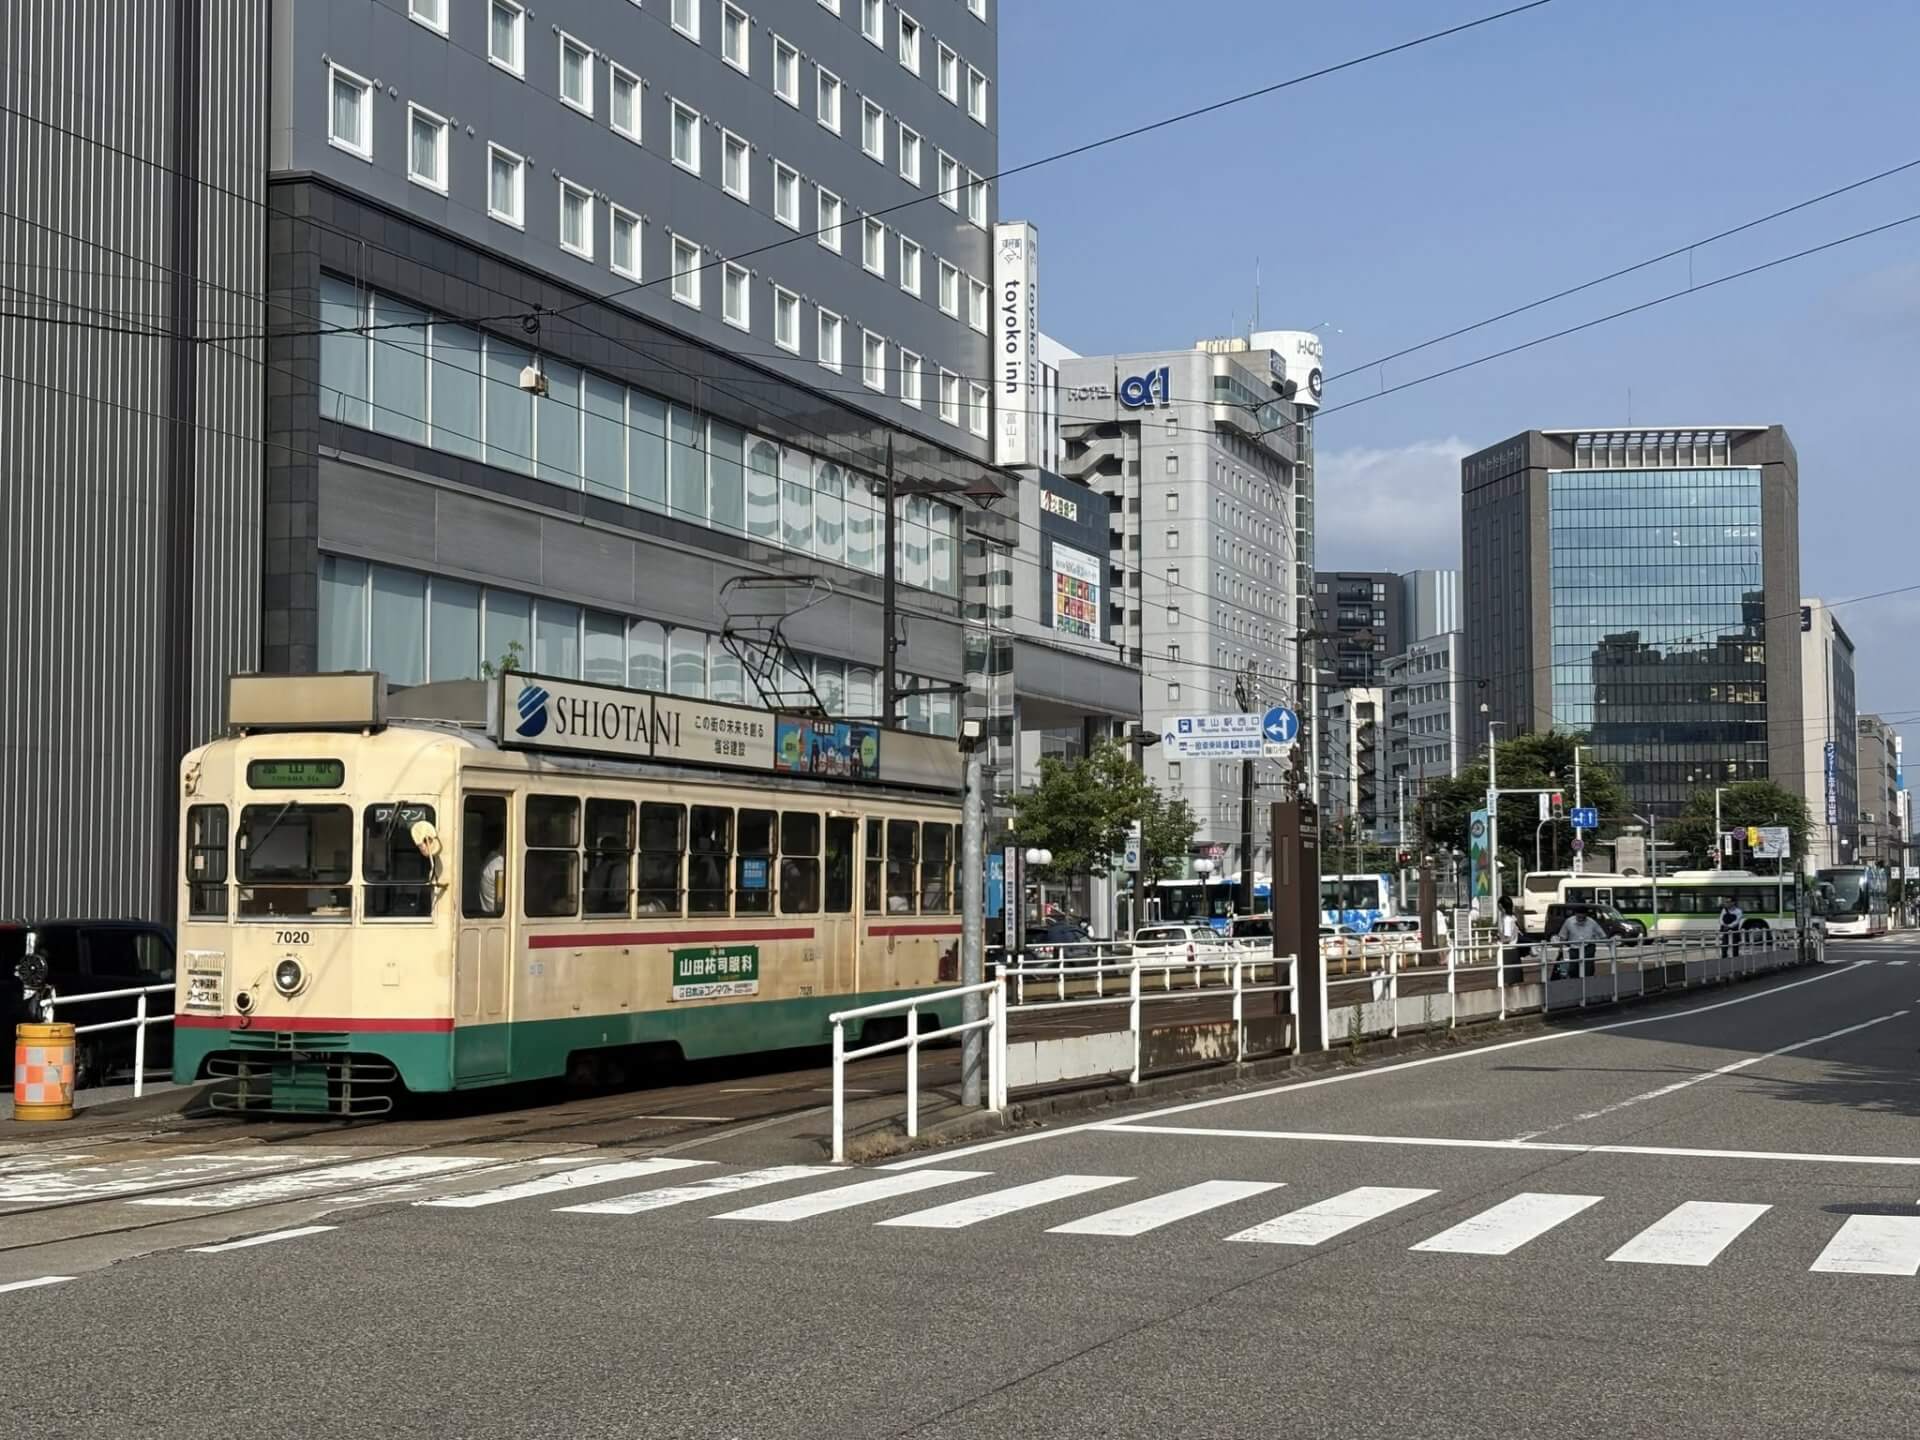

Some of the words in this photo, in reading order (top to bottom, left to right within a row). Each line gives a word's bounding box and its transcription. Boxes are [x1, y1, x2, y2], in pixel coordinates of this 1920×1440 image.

[1002, 280, 1021, 353] toyoko
[1006, 361, 1021, 394] inn
[555, 695, 681, 748] SHIOTANI
[275, 930, 310, 944] 7020
[679, 954, 753, 977] 山田祐司眼科
